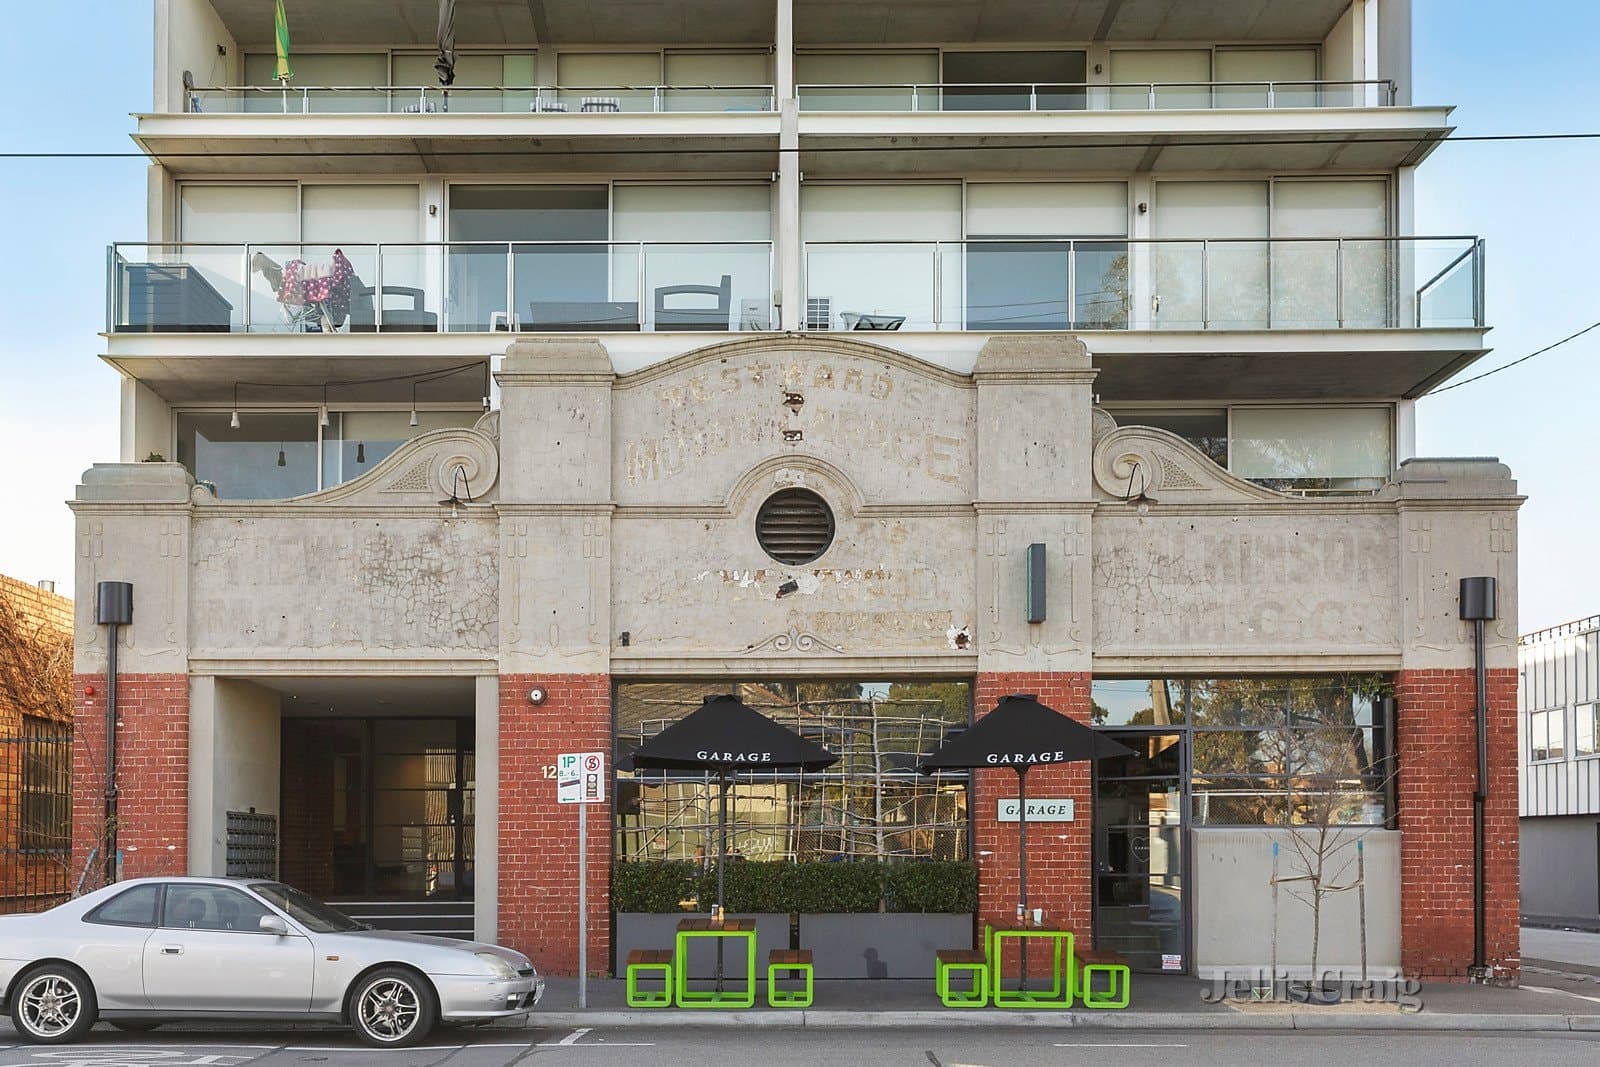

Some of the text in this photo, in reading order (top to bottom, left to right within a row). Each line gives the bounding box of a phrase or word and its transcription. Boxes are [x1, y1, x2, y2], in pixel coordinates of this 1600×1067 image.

[562, 756, 576, 769] 1P
[696, 750, 772, 762] GARAGE
[986, 751, 1064, 764] GARAGE
